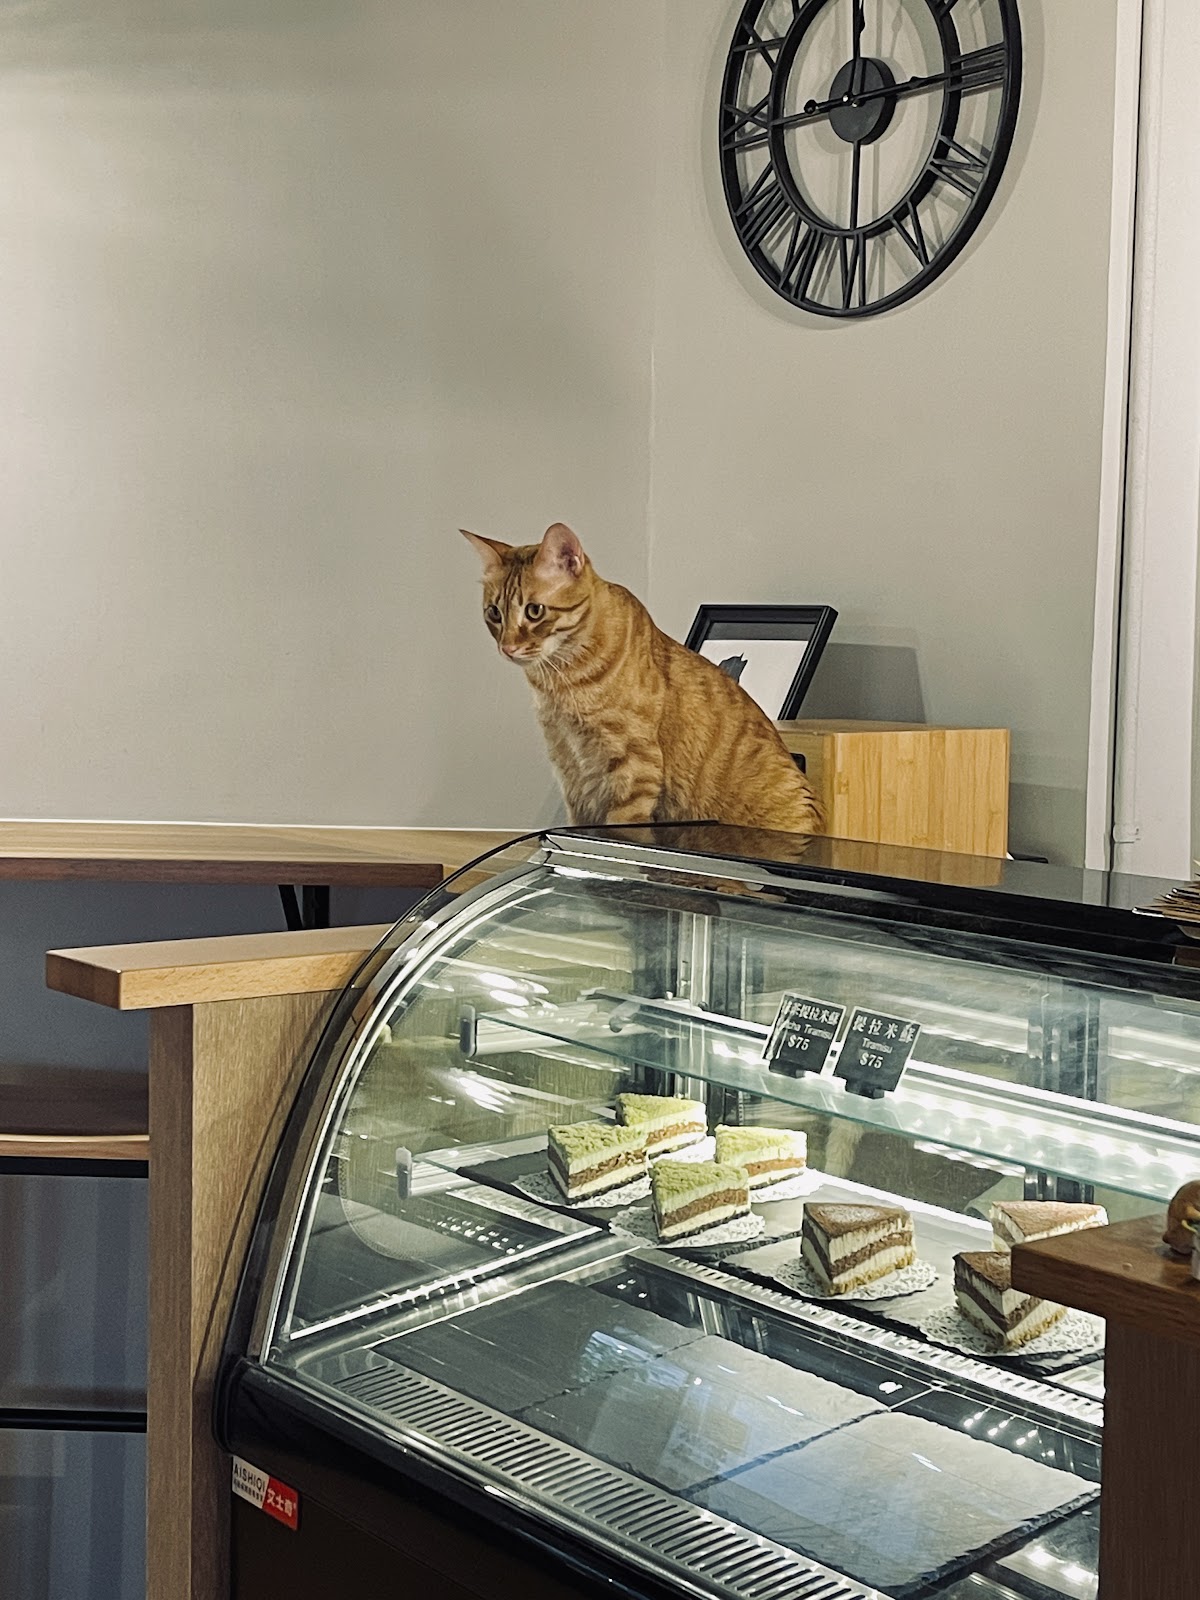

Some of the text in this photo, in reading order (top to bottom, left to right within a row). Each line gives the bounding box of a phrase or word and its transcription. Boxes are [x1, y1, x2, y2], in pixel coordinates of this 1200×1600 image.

[804, 1025, 834, 1041] Tiramisu
[852, 1014, 916, 1044] 提拉米蘇
[787, 1034, 811, 1051] $75
[861, 1037, 893, 1055] Tiramisu
[859, 1052, 884, 1069] $75
